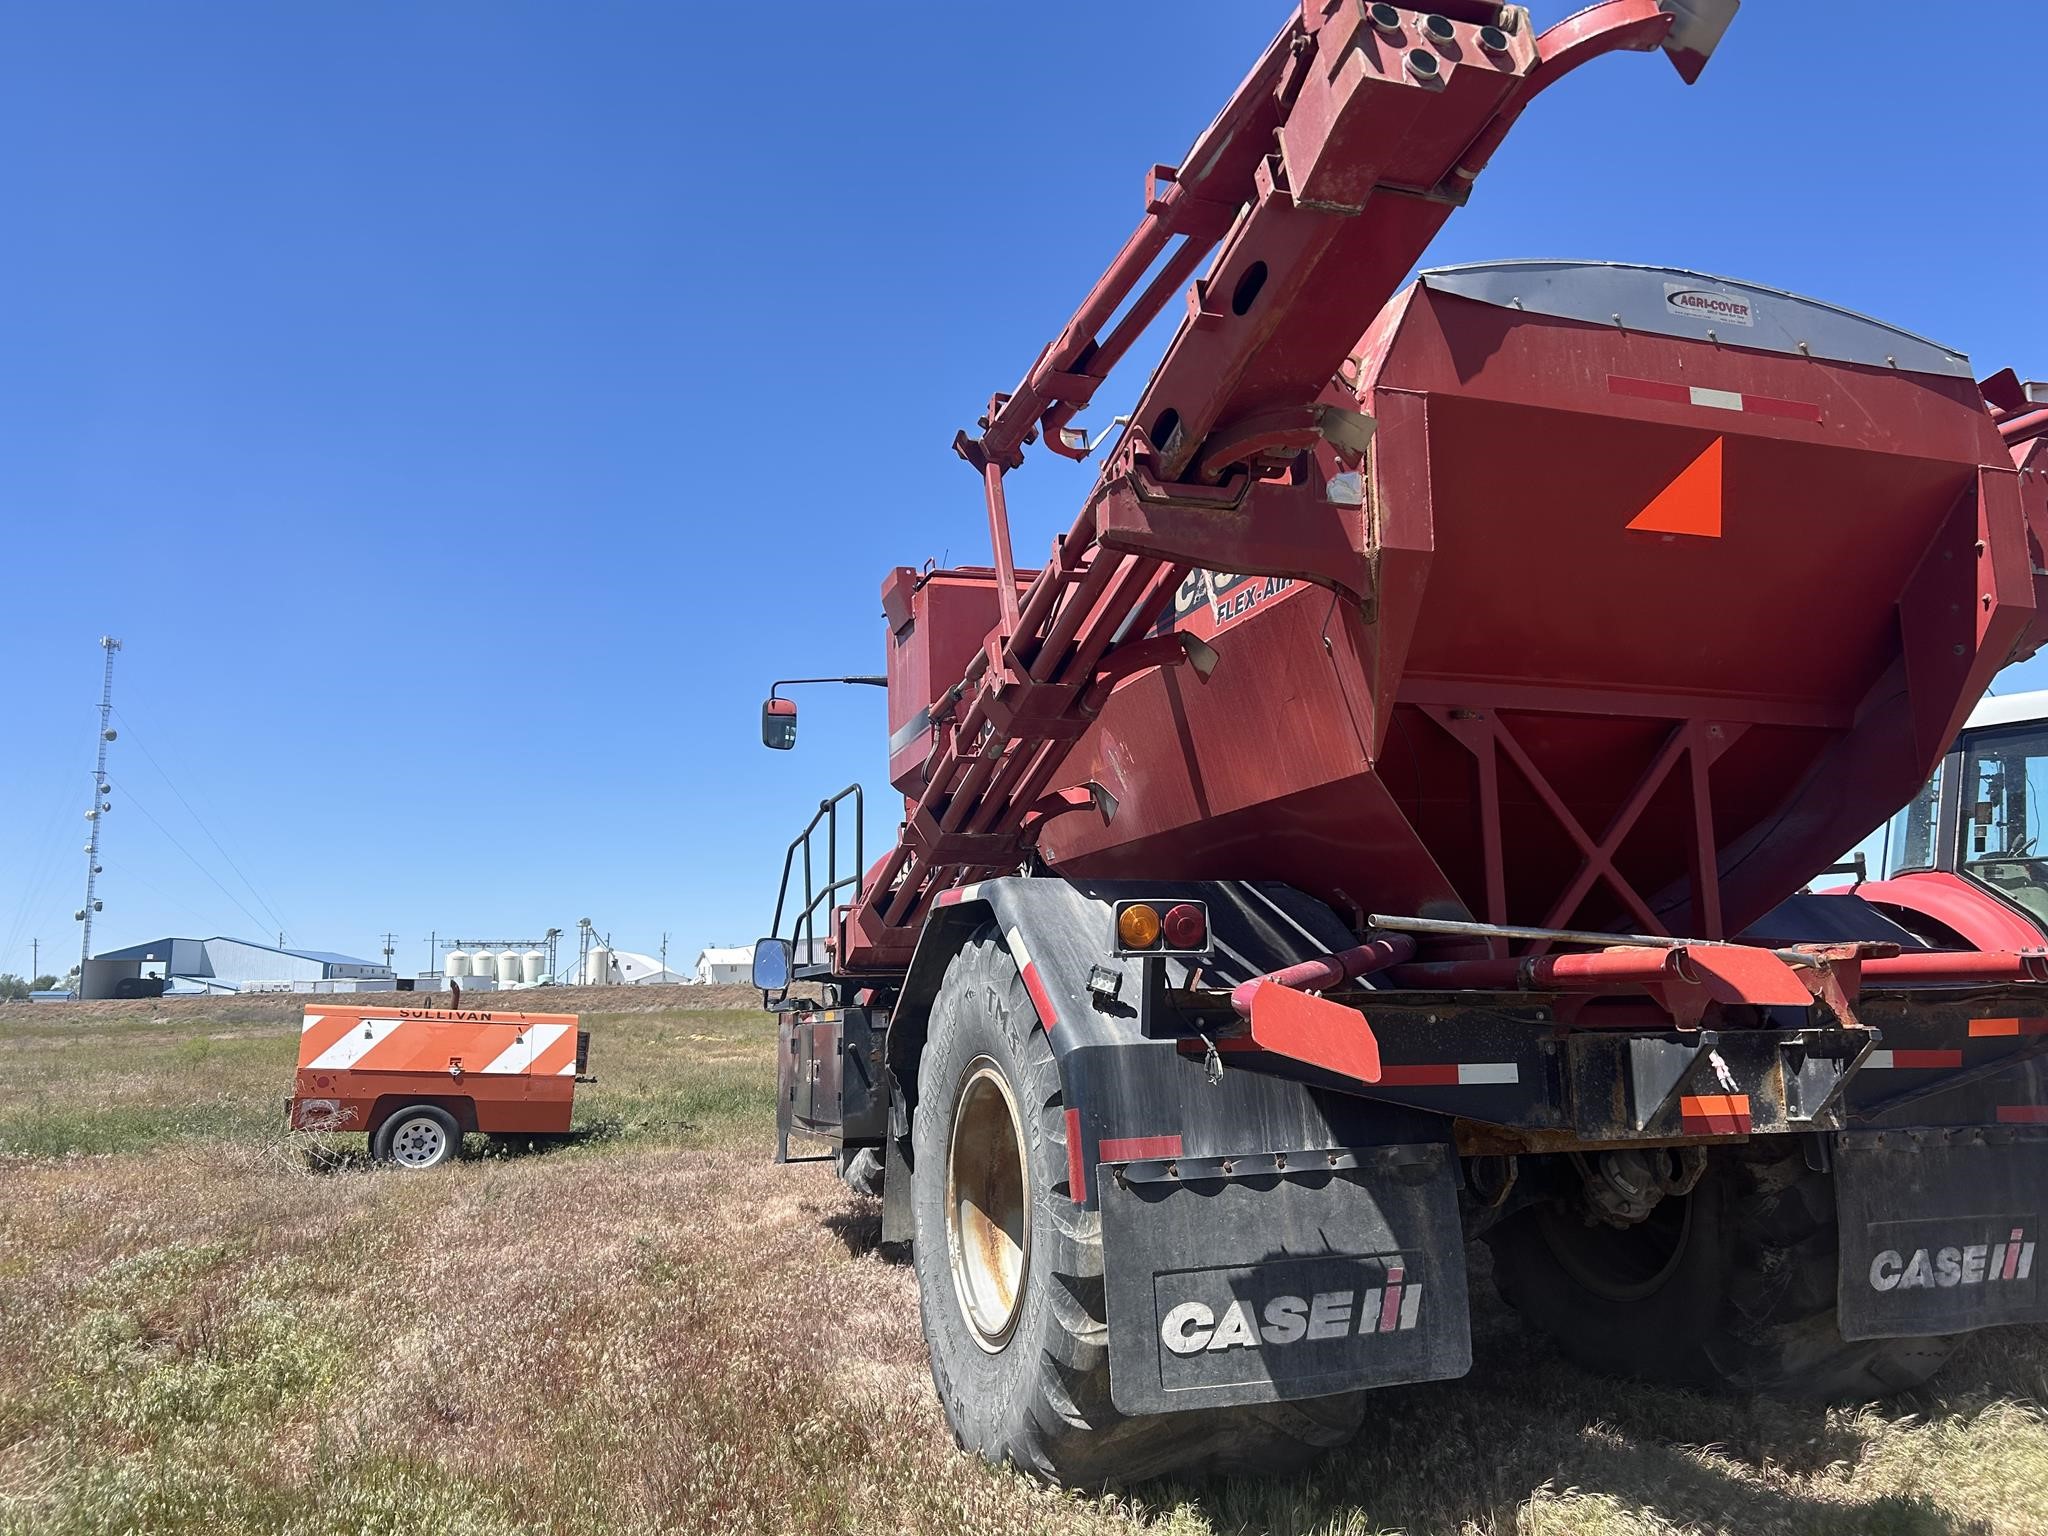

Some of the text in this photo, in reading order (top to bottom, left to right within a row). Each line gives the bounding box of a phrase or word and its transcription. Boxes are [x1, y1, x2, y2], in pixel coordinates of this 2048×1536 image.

[1680, 294, 1749, 316] AGRI-COVER
[399, 1009, 493, 1022] SULLIVAN
[1868, 1244, 1988, 1292] CASE
[1161, 1290, 1354, 1354] CASE
